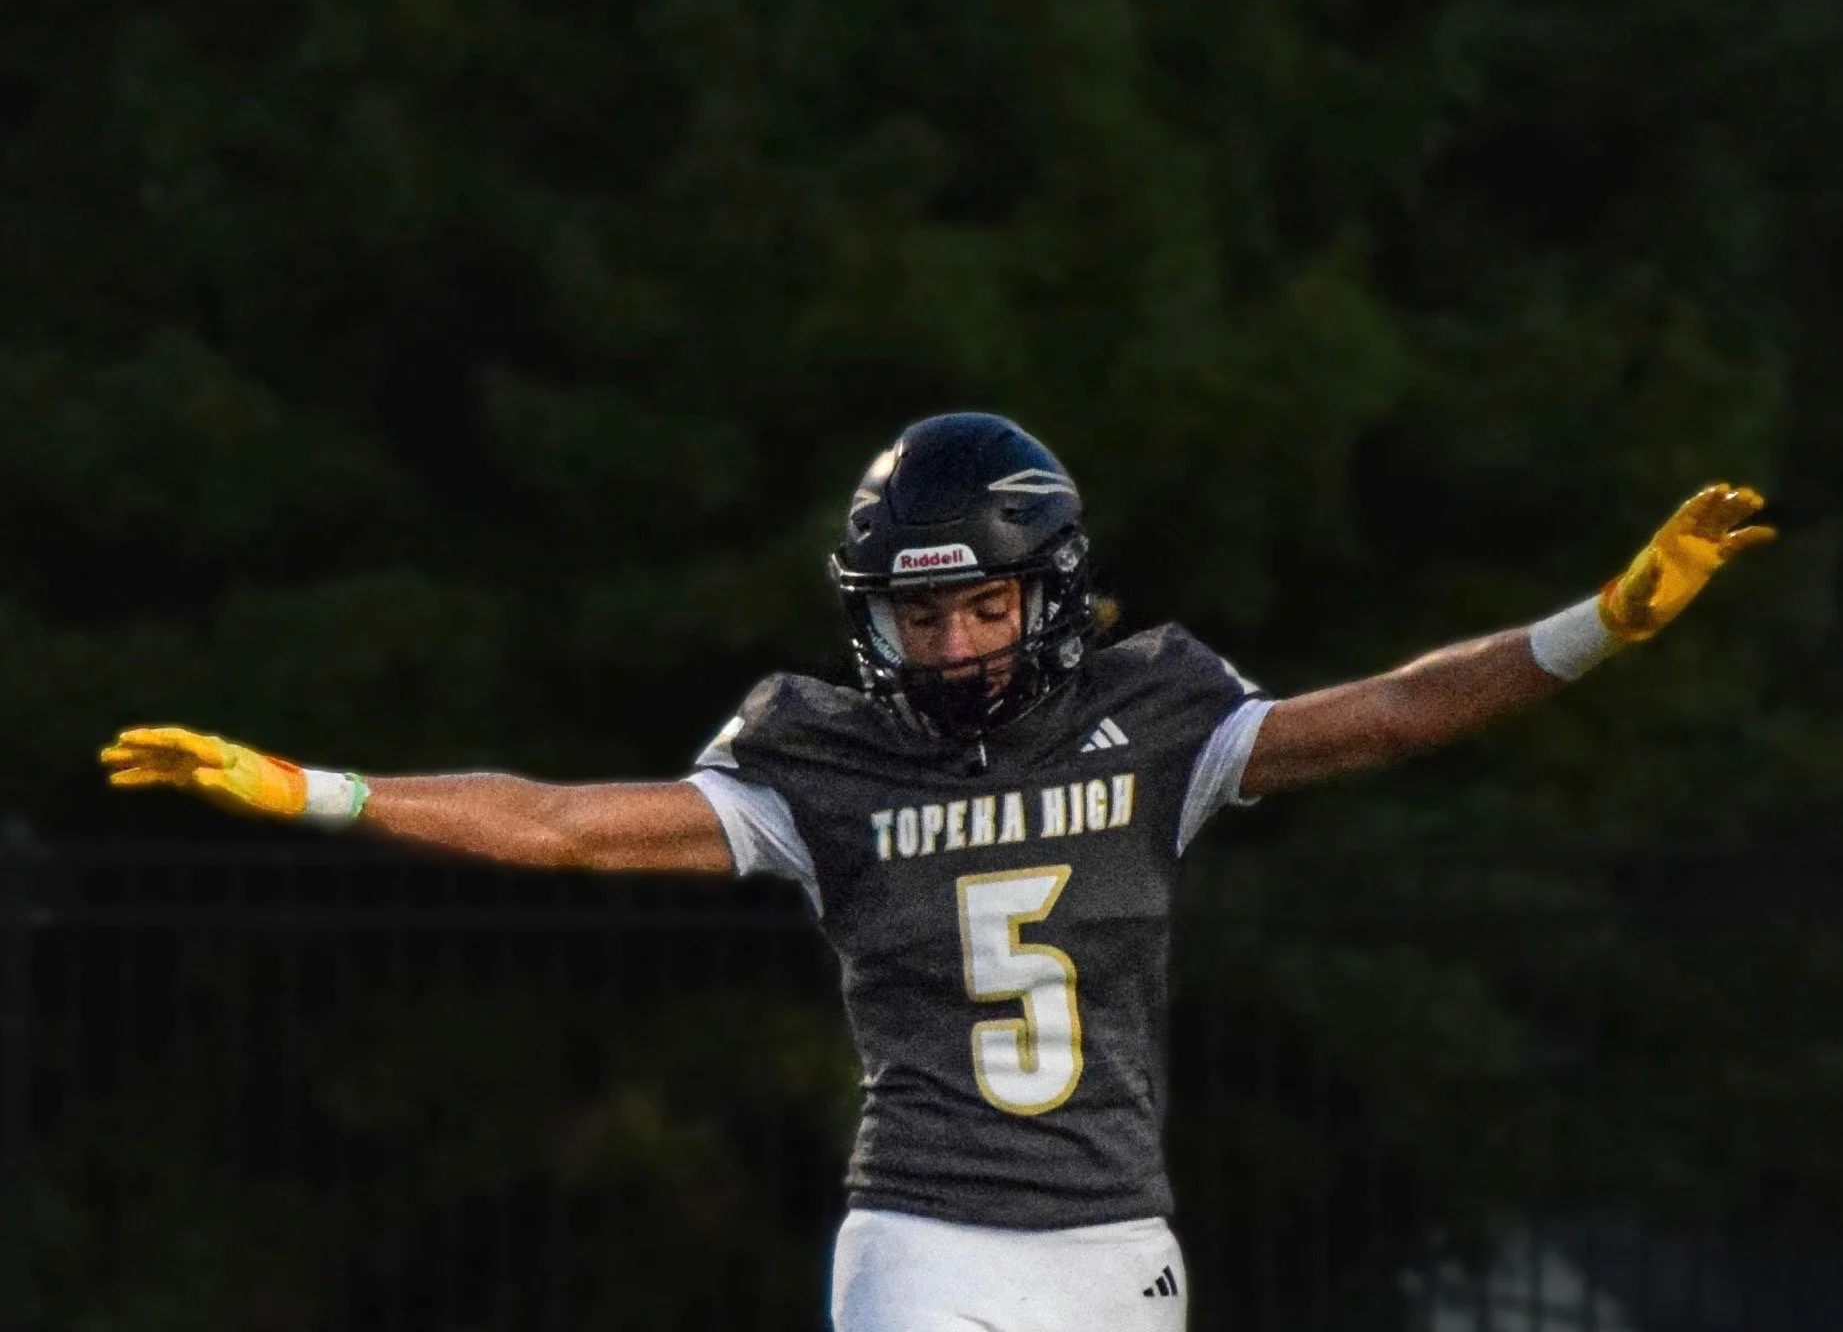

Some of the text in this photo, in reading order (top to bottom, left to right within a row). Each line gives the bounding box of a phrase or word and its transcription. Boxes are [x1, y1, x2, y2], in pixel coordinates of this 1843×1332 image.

[901, 549, 963, 568] Riddell
[871, 773, 1135, 861] TOPEKA HIGH
[956, 864, 1084, 1115] 5
